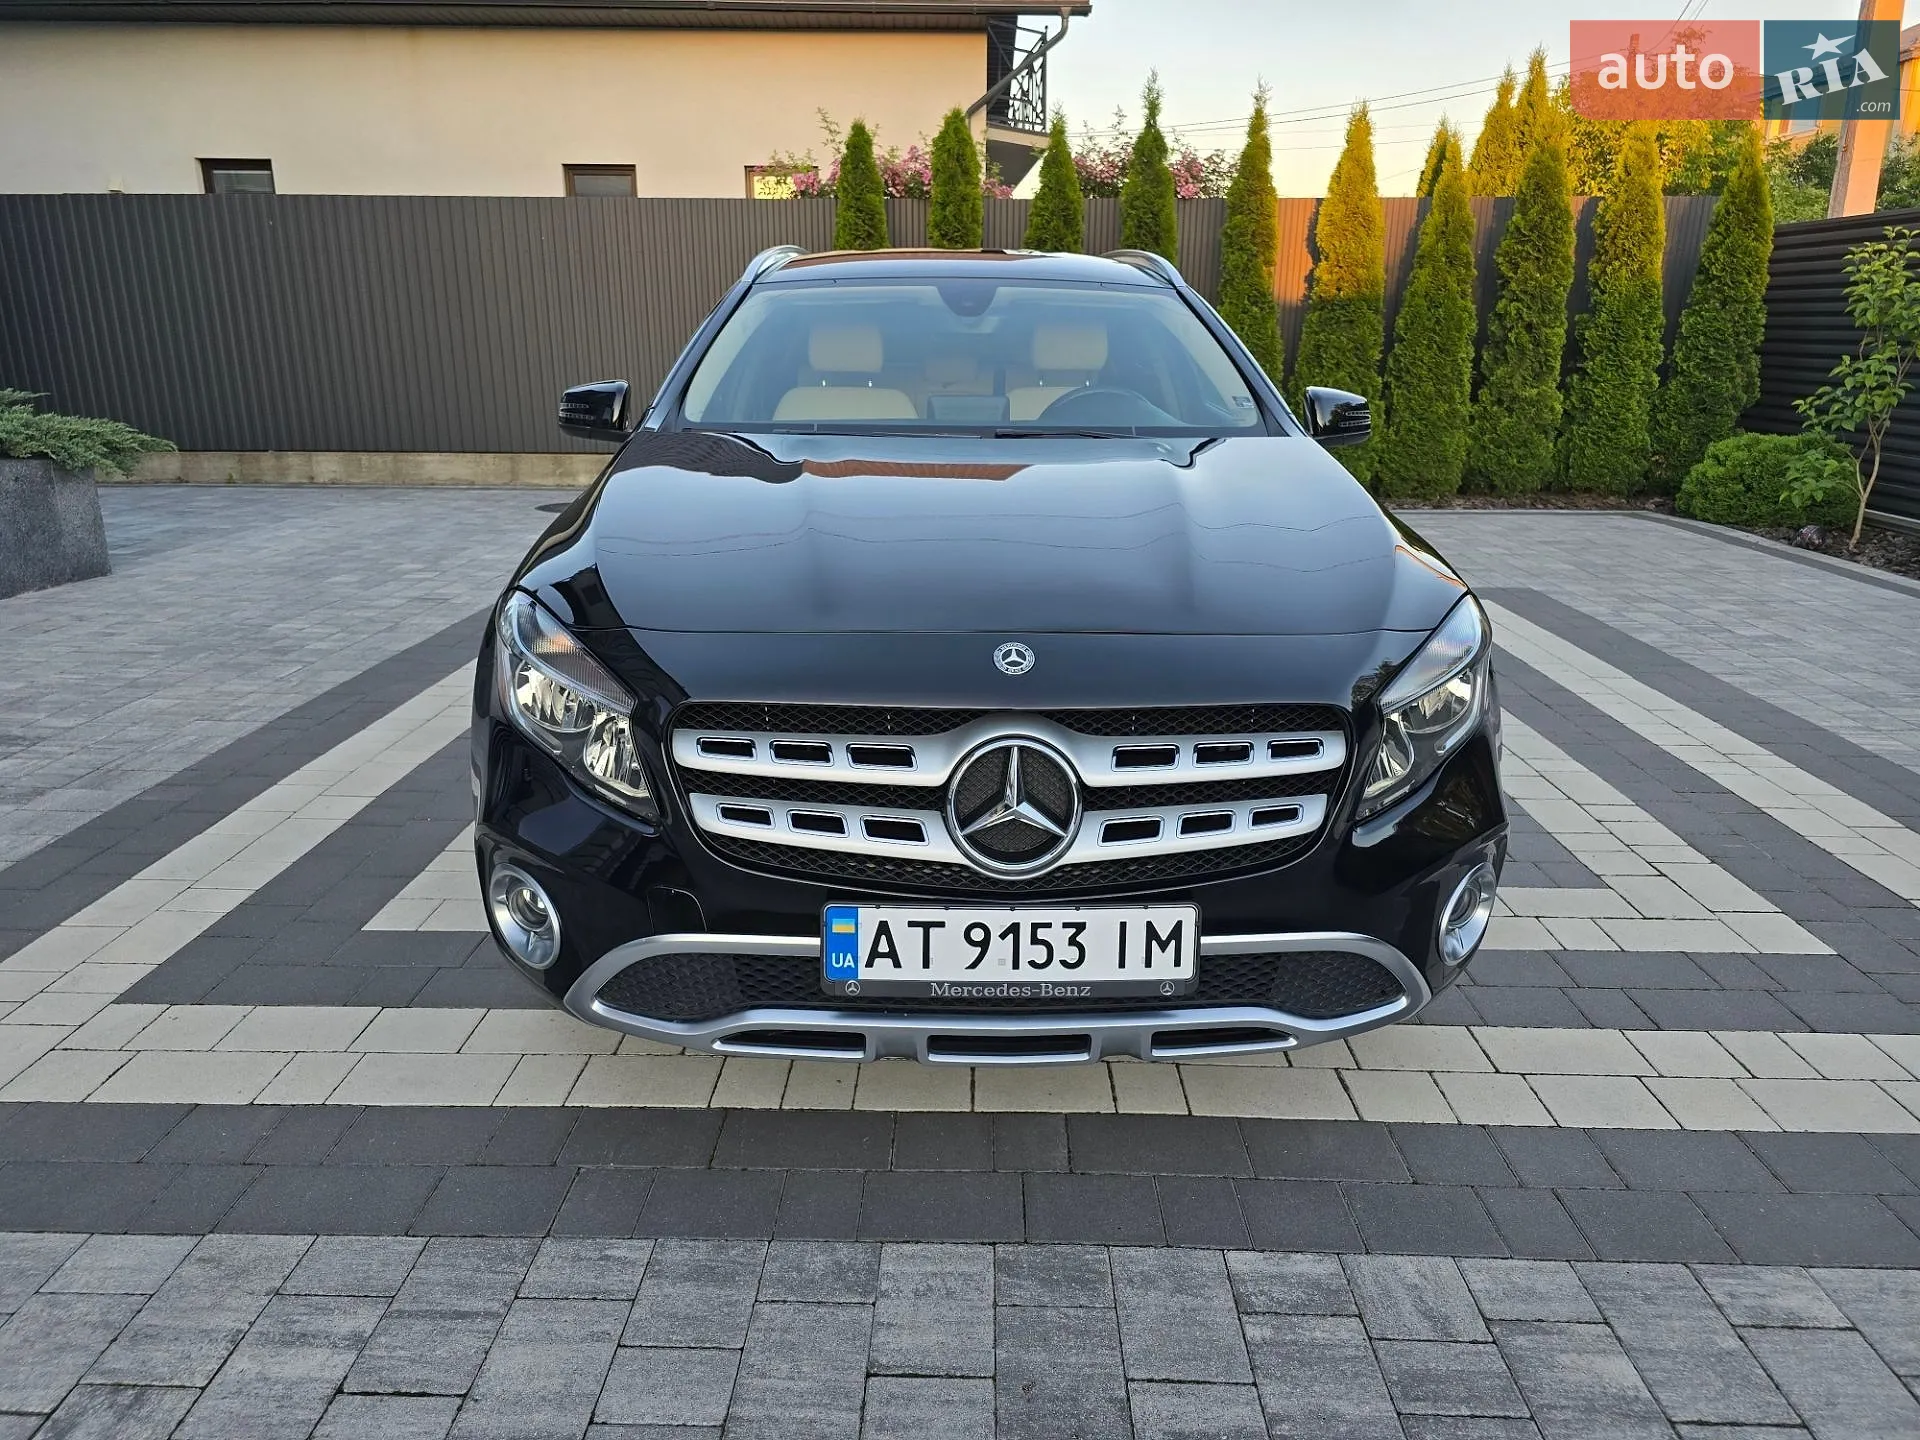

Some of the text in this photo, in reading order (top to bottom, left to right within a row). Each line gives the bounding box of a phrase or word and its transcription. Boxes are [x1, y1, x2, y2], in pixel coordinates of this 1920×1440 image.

[864, 920, 1183, 970] AT 9153 IM
[831, 953, 855, 968] UA
[931, 982, 1091, 998] Mercedes-Benz
